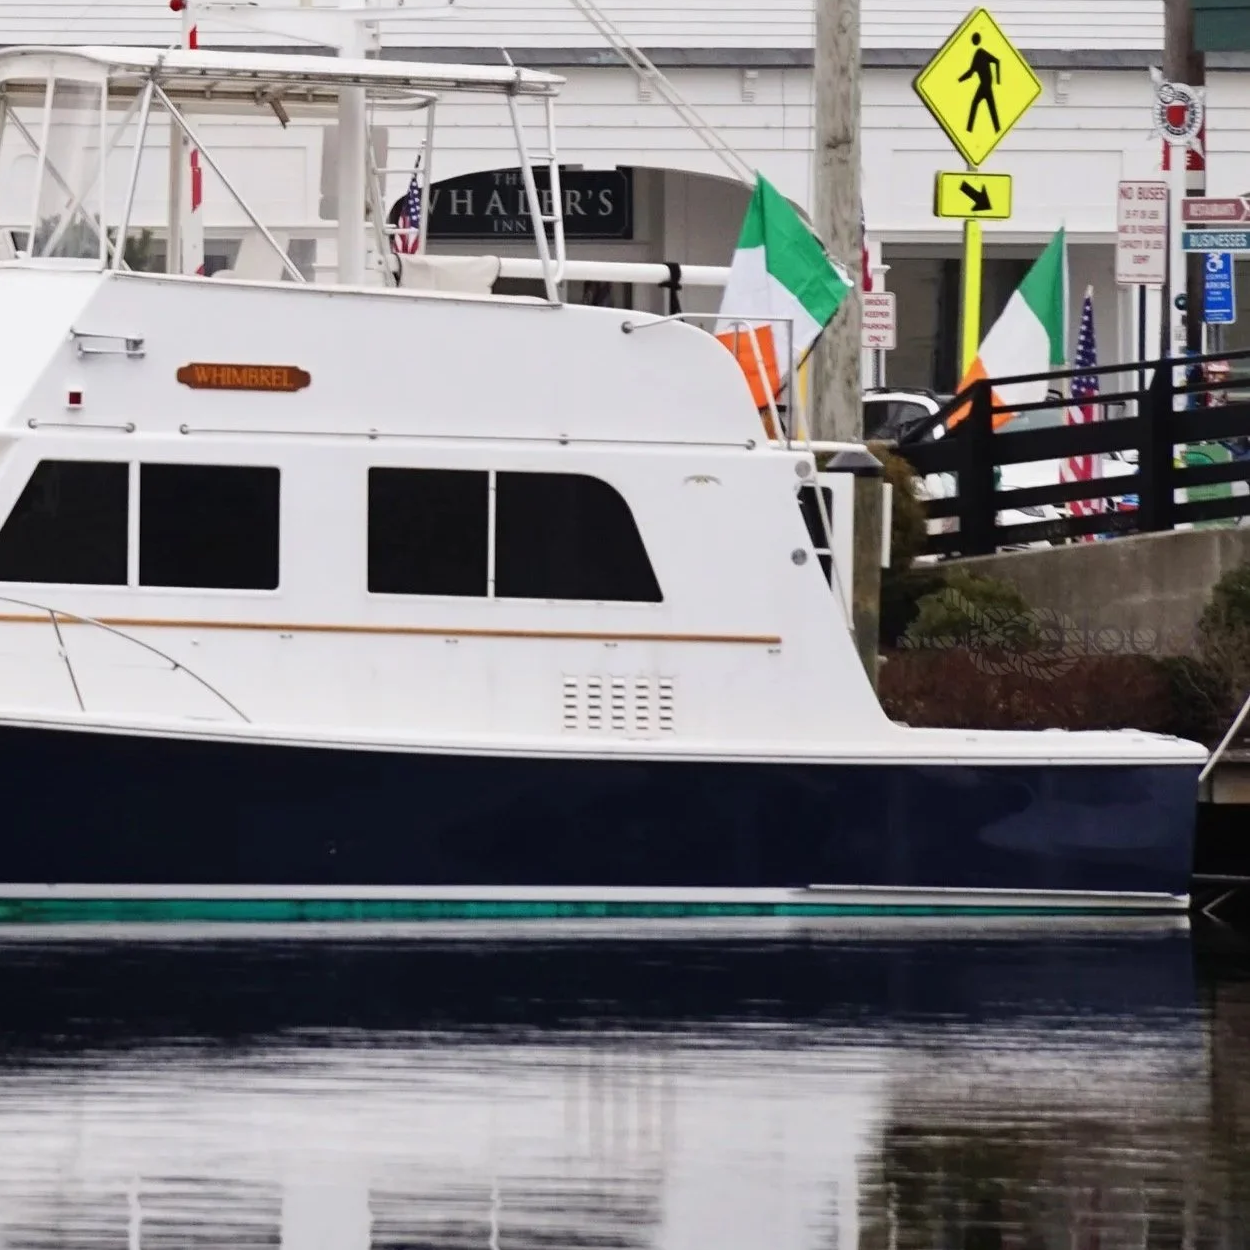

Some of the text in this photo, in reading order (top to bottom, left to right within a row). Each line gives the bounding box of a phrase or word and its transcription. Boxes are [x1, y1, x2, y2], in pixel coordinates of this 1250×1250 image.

[1119, 187, 1166, 200] NO BUSES
[494, 220, 527, 232] INN
[1190, 234, 1247, 247] BUSINESSES
[862, 322, 894, 330] PARKING
[194, 366, 294, 387] WHIMBREL
